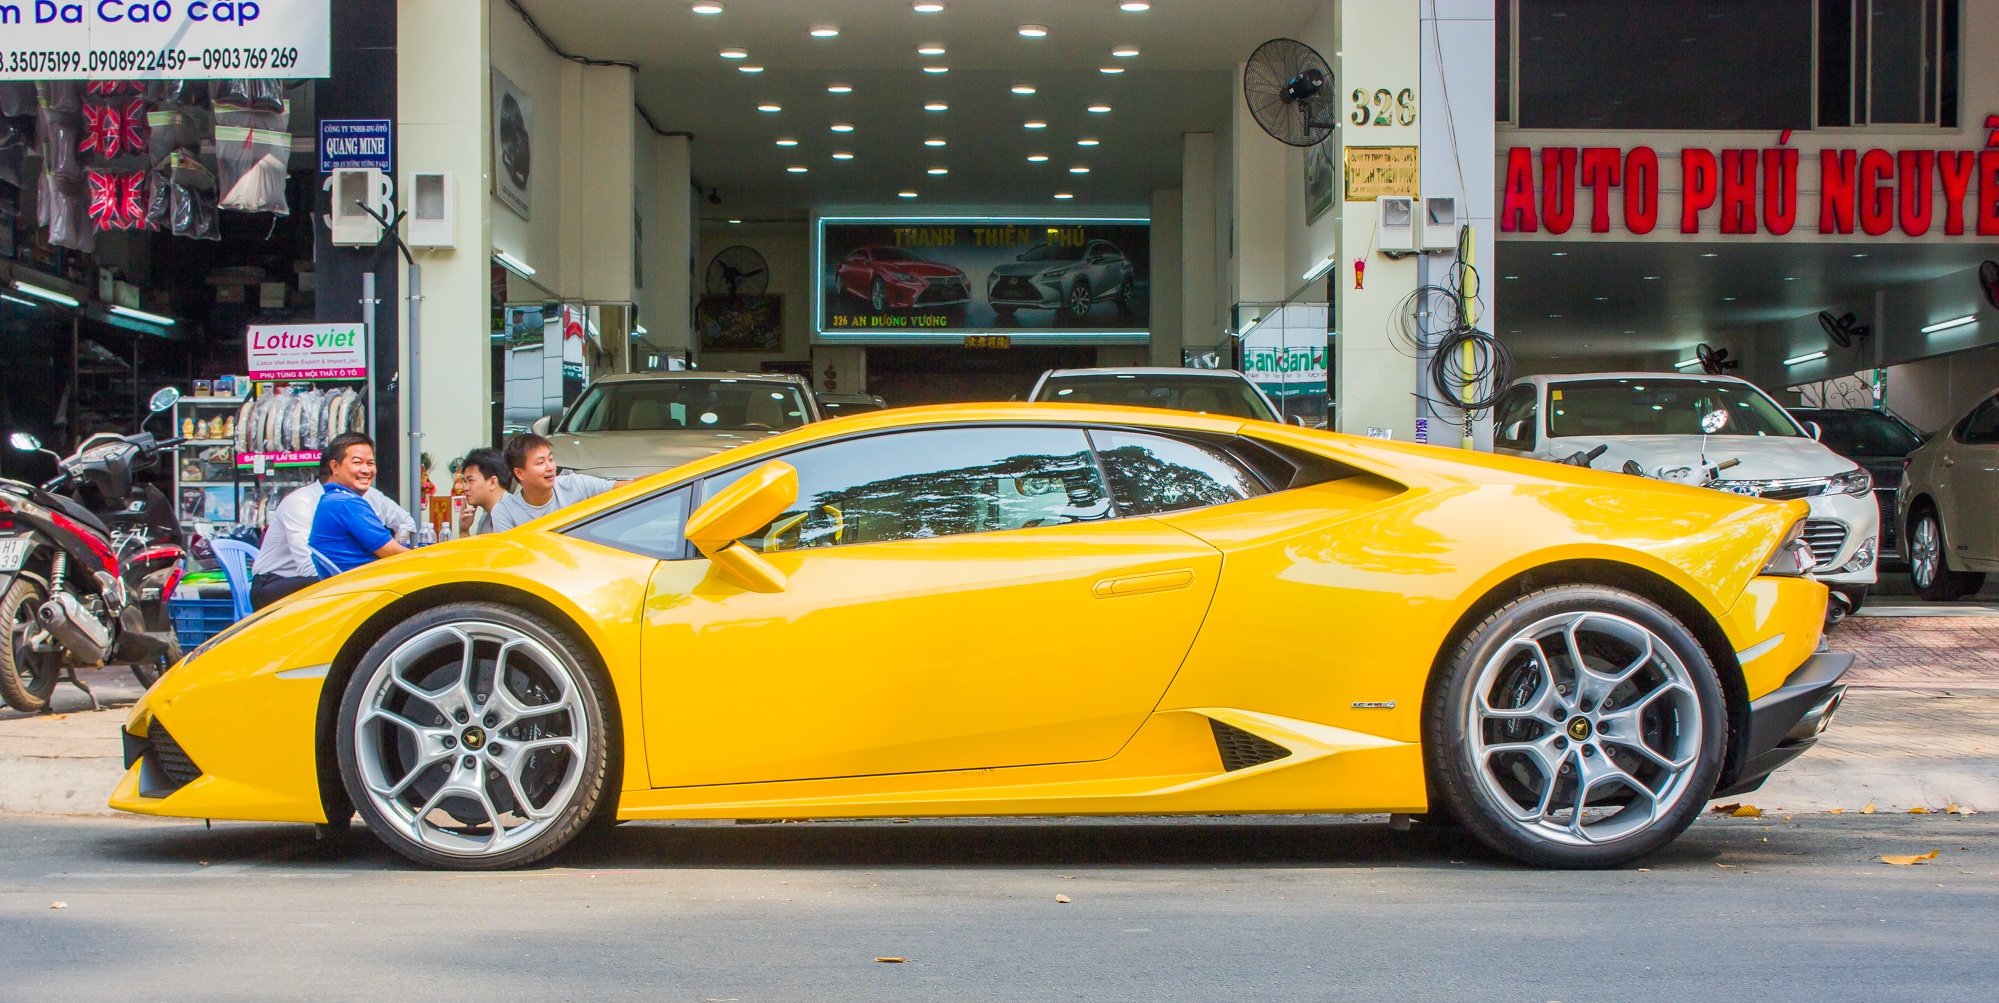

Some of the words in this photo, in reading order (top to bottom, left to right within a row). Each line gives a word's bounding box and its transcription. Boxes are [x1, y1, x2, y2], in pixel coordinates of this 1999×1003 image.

[35, 0, 82, 24] Da
[1351, 88, 1415, 126] 326
[326, 138, 358, 158] QUANG
[359, 137, 385, 155] MINH
[1501, 146, 1658, 235] AUTO
[1681, 128, 1799, 235] PHÚ
[893, 228, 955, 247] THANH
[973, 225, 1030, 247] THIÊN
[1047, 225, 1085, 247] PHÚ
[833, 315, 848, 327] 326
[851, 316, 867, 327] AN
[253, 328, 356, 350] Lotusviet
[305, 370, 318, 379] NỘI
[320, 369, 338, 377] THẤT
[340, 369, 346, 377] Ô
[347, 368, 358, 376] TÔ
